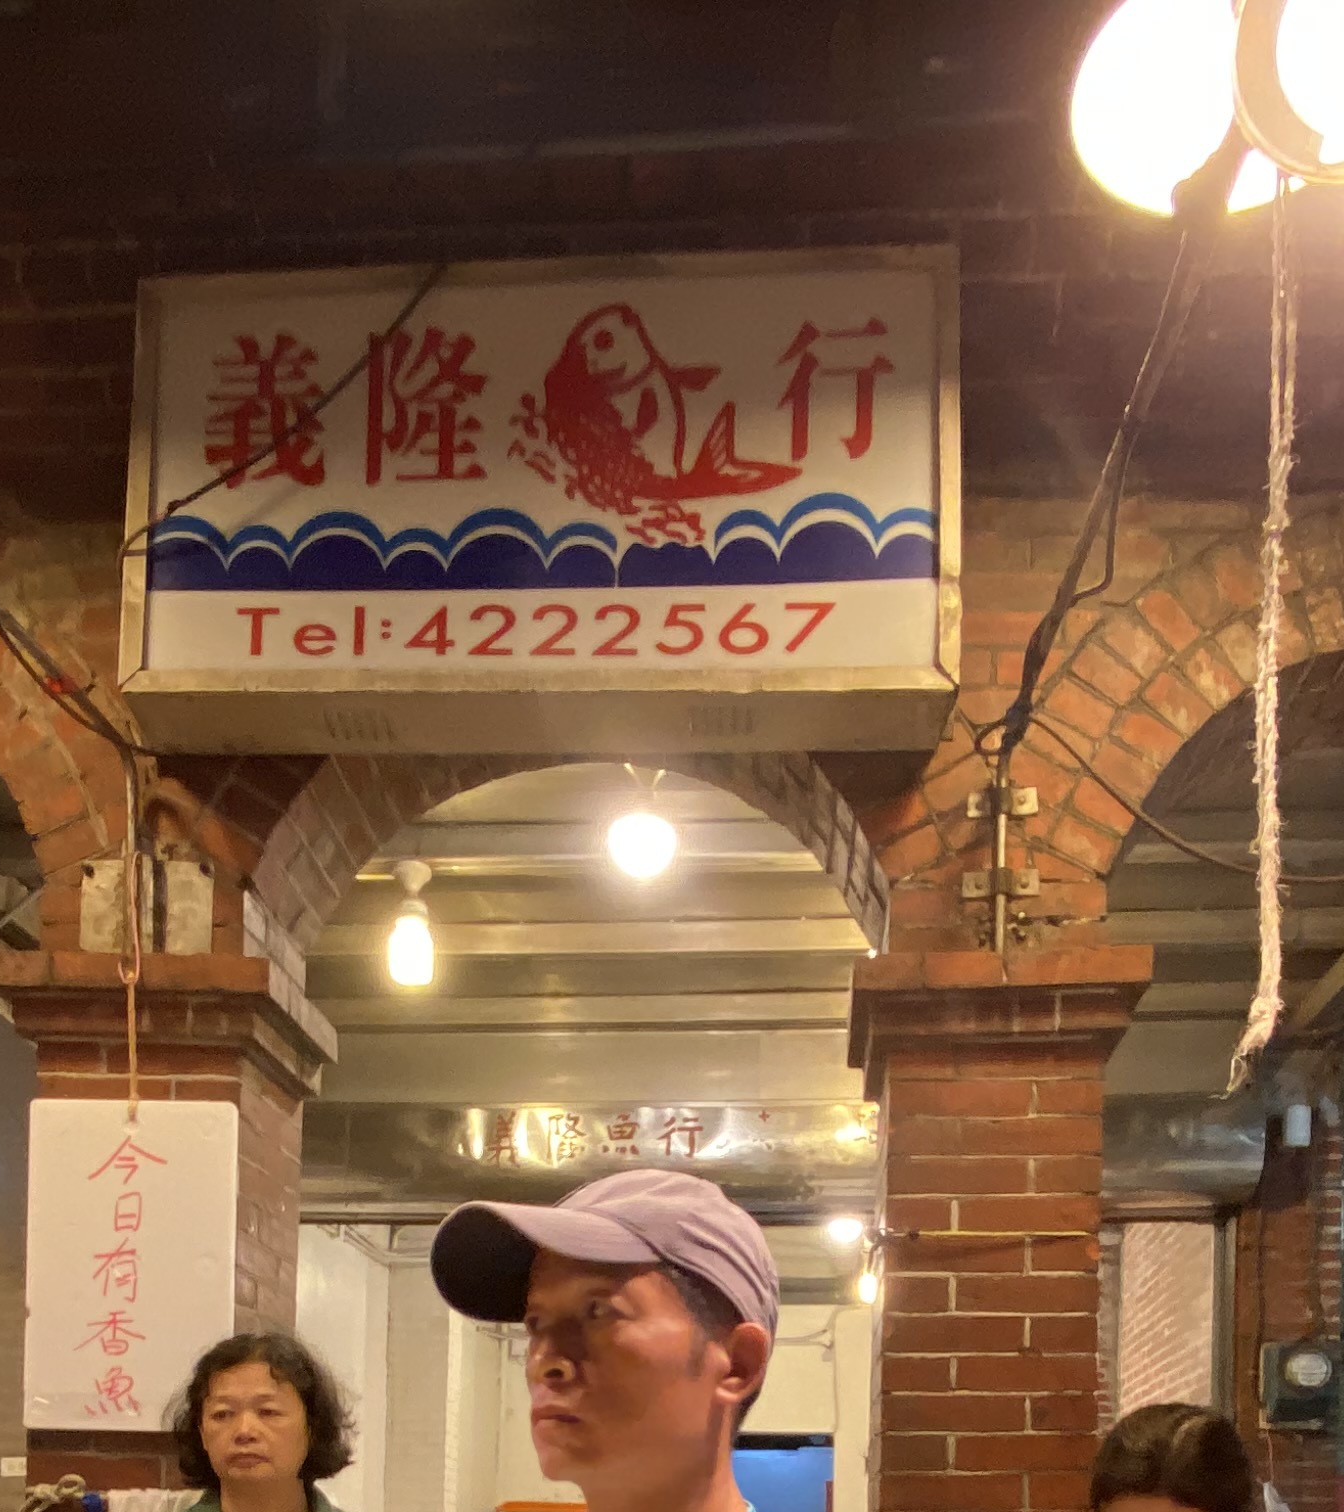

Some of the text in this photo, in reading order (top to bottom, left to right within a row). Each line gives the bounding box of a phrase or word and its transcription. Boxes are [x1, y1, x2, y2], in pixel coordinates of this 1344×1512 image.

[237, 602, 837, 657] Tel:4222567
[73, 1134, 168, 1417] 今日有香魚
